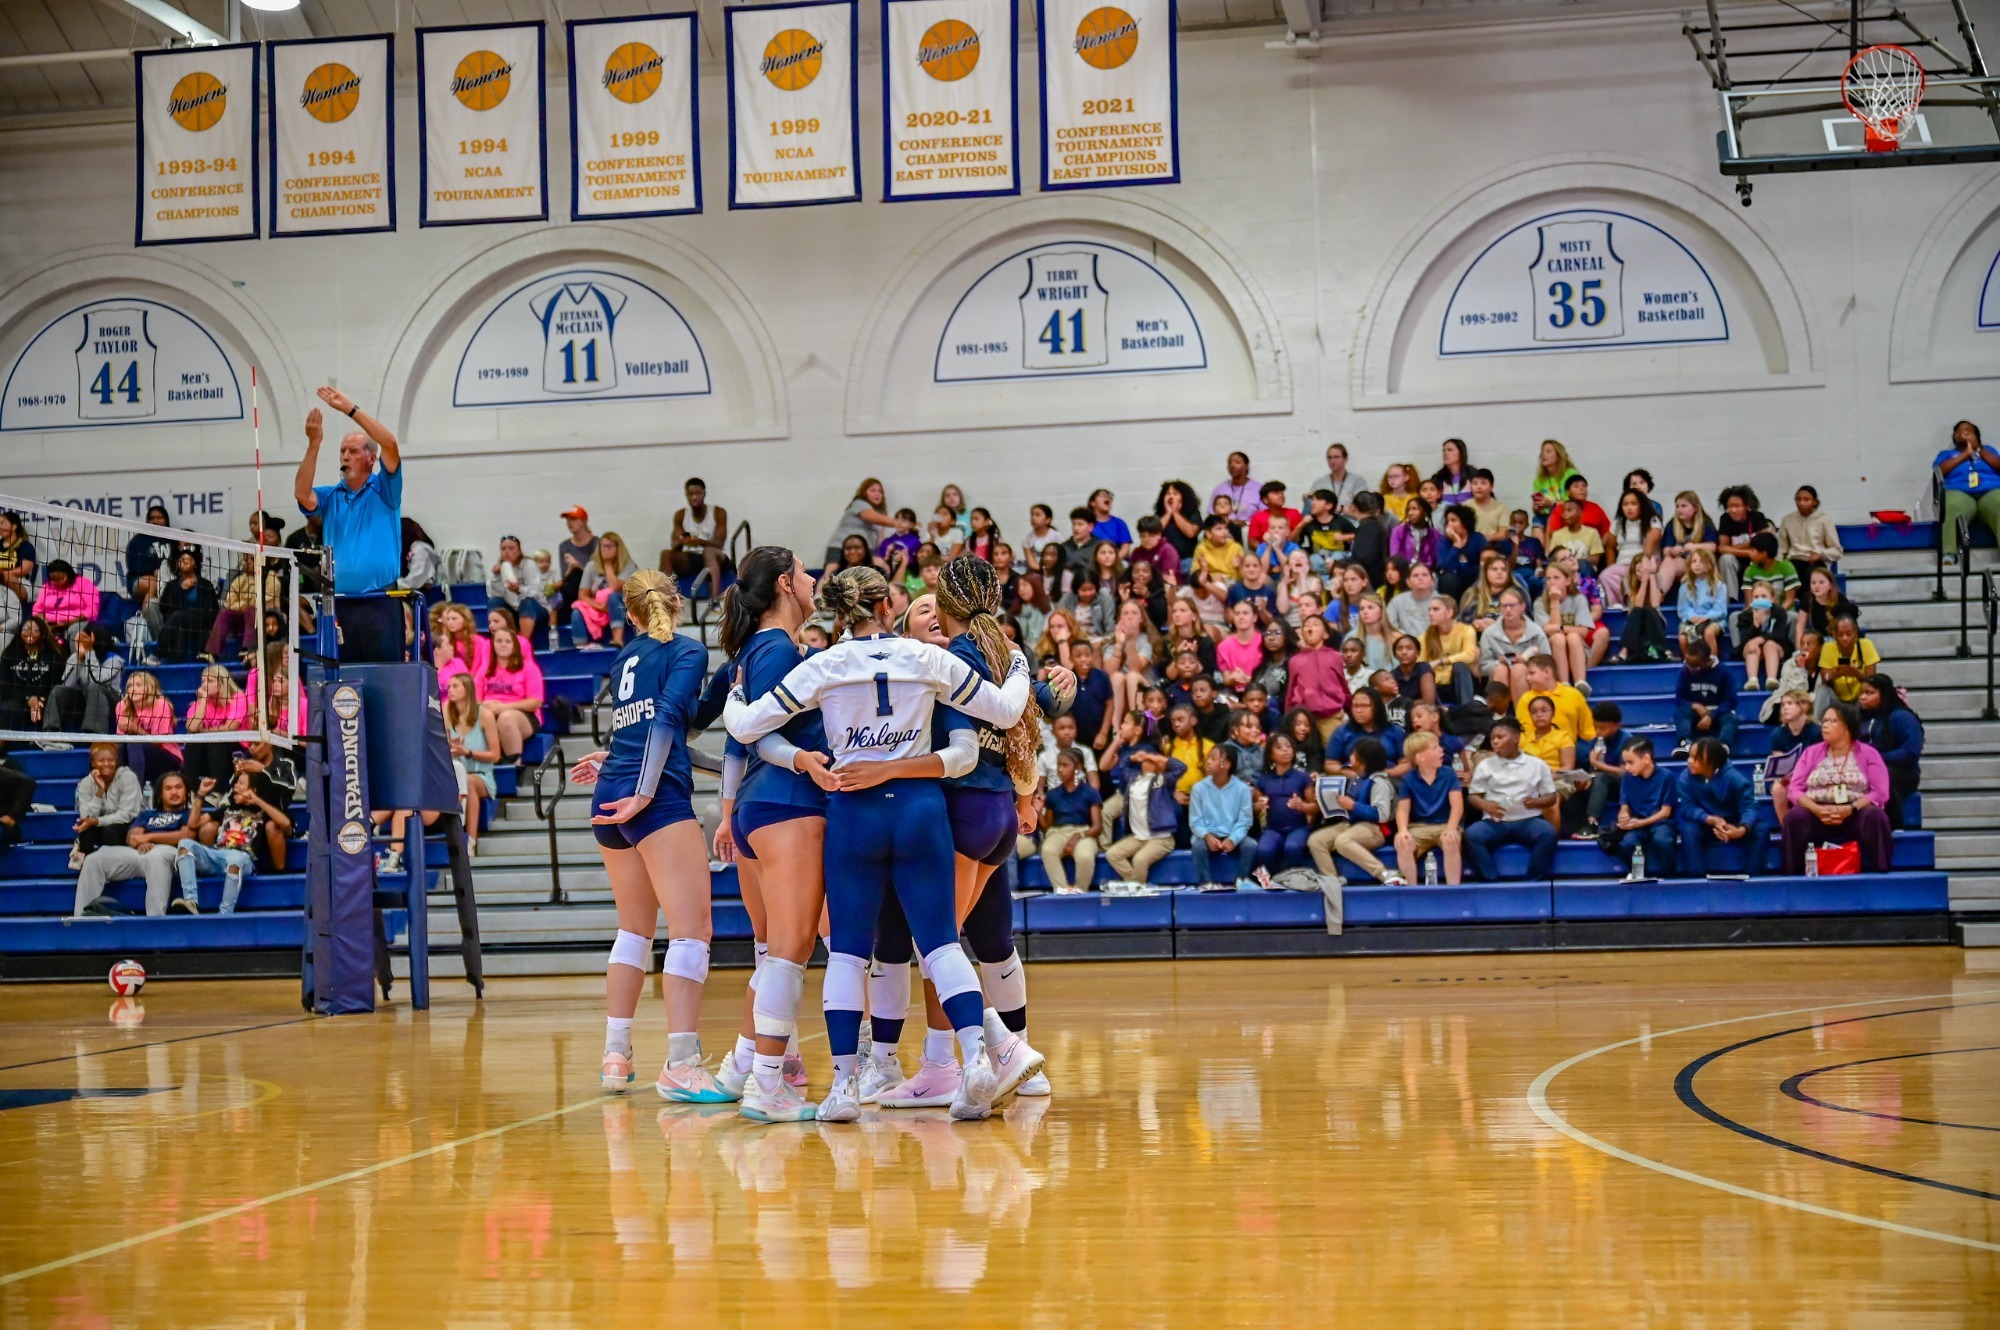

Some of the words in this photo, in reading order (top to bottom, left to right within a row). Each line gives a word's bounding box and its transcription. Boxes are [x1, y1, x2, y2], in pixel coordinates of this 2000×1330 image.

[1082, 98, 1135, 115] 2021
[906, 109, 993, 128] 2020-21
[770, 118, 820, 136] 1999
[1056, 123, 1162, 139] CONFERENCE
[458, 138, 508, 155] 1994
[610, 130, 660, 148] 1999
[899, 135, 1004, 151] CONFERENCE
[1055, 136, 1164, 152] TOURNAMENT
[307, 150, 356, 167] 1994
[775, 147, 815, 159] NCAA
[906, 151, 998, 166] CHAMPIONS
[1063, 150, 1157, 166] CHAMPIONS
[157, 157, 238, 175] 1993-94
[586, 155, 686, 172] CONFERENCE
[1053, 166, 1092, 180] EAST
[1096, 162, 1168, 177] DIVISION
[464, 166, 504, 178] NCAA
[585, 169, 687, 187] TOURNAMENT
[743, 166, 847, 184] TOURNAMENT
[896, 167, 934, 181] EAST
[938, 165, 1008, 179] DIVISION
[285, 173, 380, 190] CONFERENCE
[151, 183, 244, 200] CONFERENCE
[284, 188, 382, 204] TOURNAMENT
[434, 186, 535, 202] TOURNAMENT
[593, 185, 681, 201] CHAMPIONS
[156, 205, 240, 221] CHAMPIONS
[290, 203, 376, 219] CHAMPIONS
[1560, 241, 1591, 253] MISTY
[1548, 257, 1604, 272] CARNEAL
[1046, 269, 1078, 283] TERRY
[1037, 285, 1089, 300] WRIGHT
[1643, 290, 1698, 305] Women's
[1548, 280, 1606, 328] 35
[1460, 312, 1519, 326] 1998-2002
[1637, 307, 1704, 323] Basketball
[99, 326, 131, 337] ROGER
[556, 319, 603, 334] McCLAIN
[1038, 308, 1087, 355] 41
[1135, 319, 1169, 333] Men's
[94, 340, 138, 354] TAYLOR
[955, 342, 1008, 355] 1981-1985
[1120, 334, 1184, 350] Basketball
[559, 338, 600, 384] 11
[625, 359, 689, 376] Volleyball
[181, 373, 210, 385] Men's
[478, 367, 529, 380] 1979-1980
[90, 360, 141, 405] 44
[17, 395, 66, 408] 1968-1970
[167, 387, 224, 402] Basketball
[130, 495, 165, 517] TO
[173, 492, 223, 515] THE
[618, 655, 640, 702] 6
[873, 672, 893, 717] 1
[612, 697, 656, 732] ISHOPS
[340, 718, 364, 819] SPALDING
